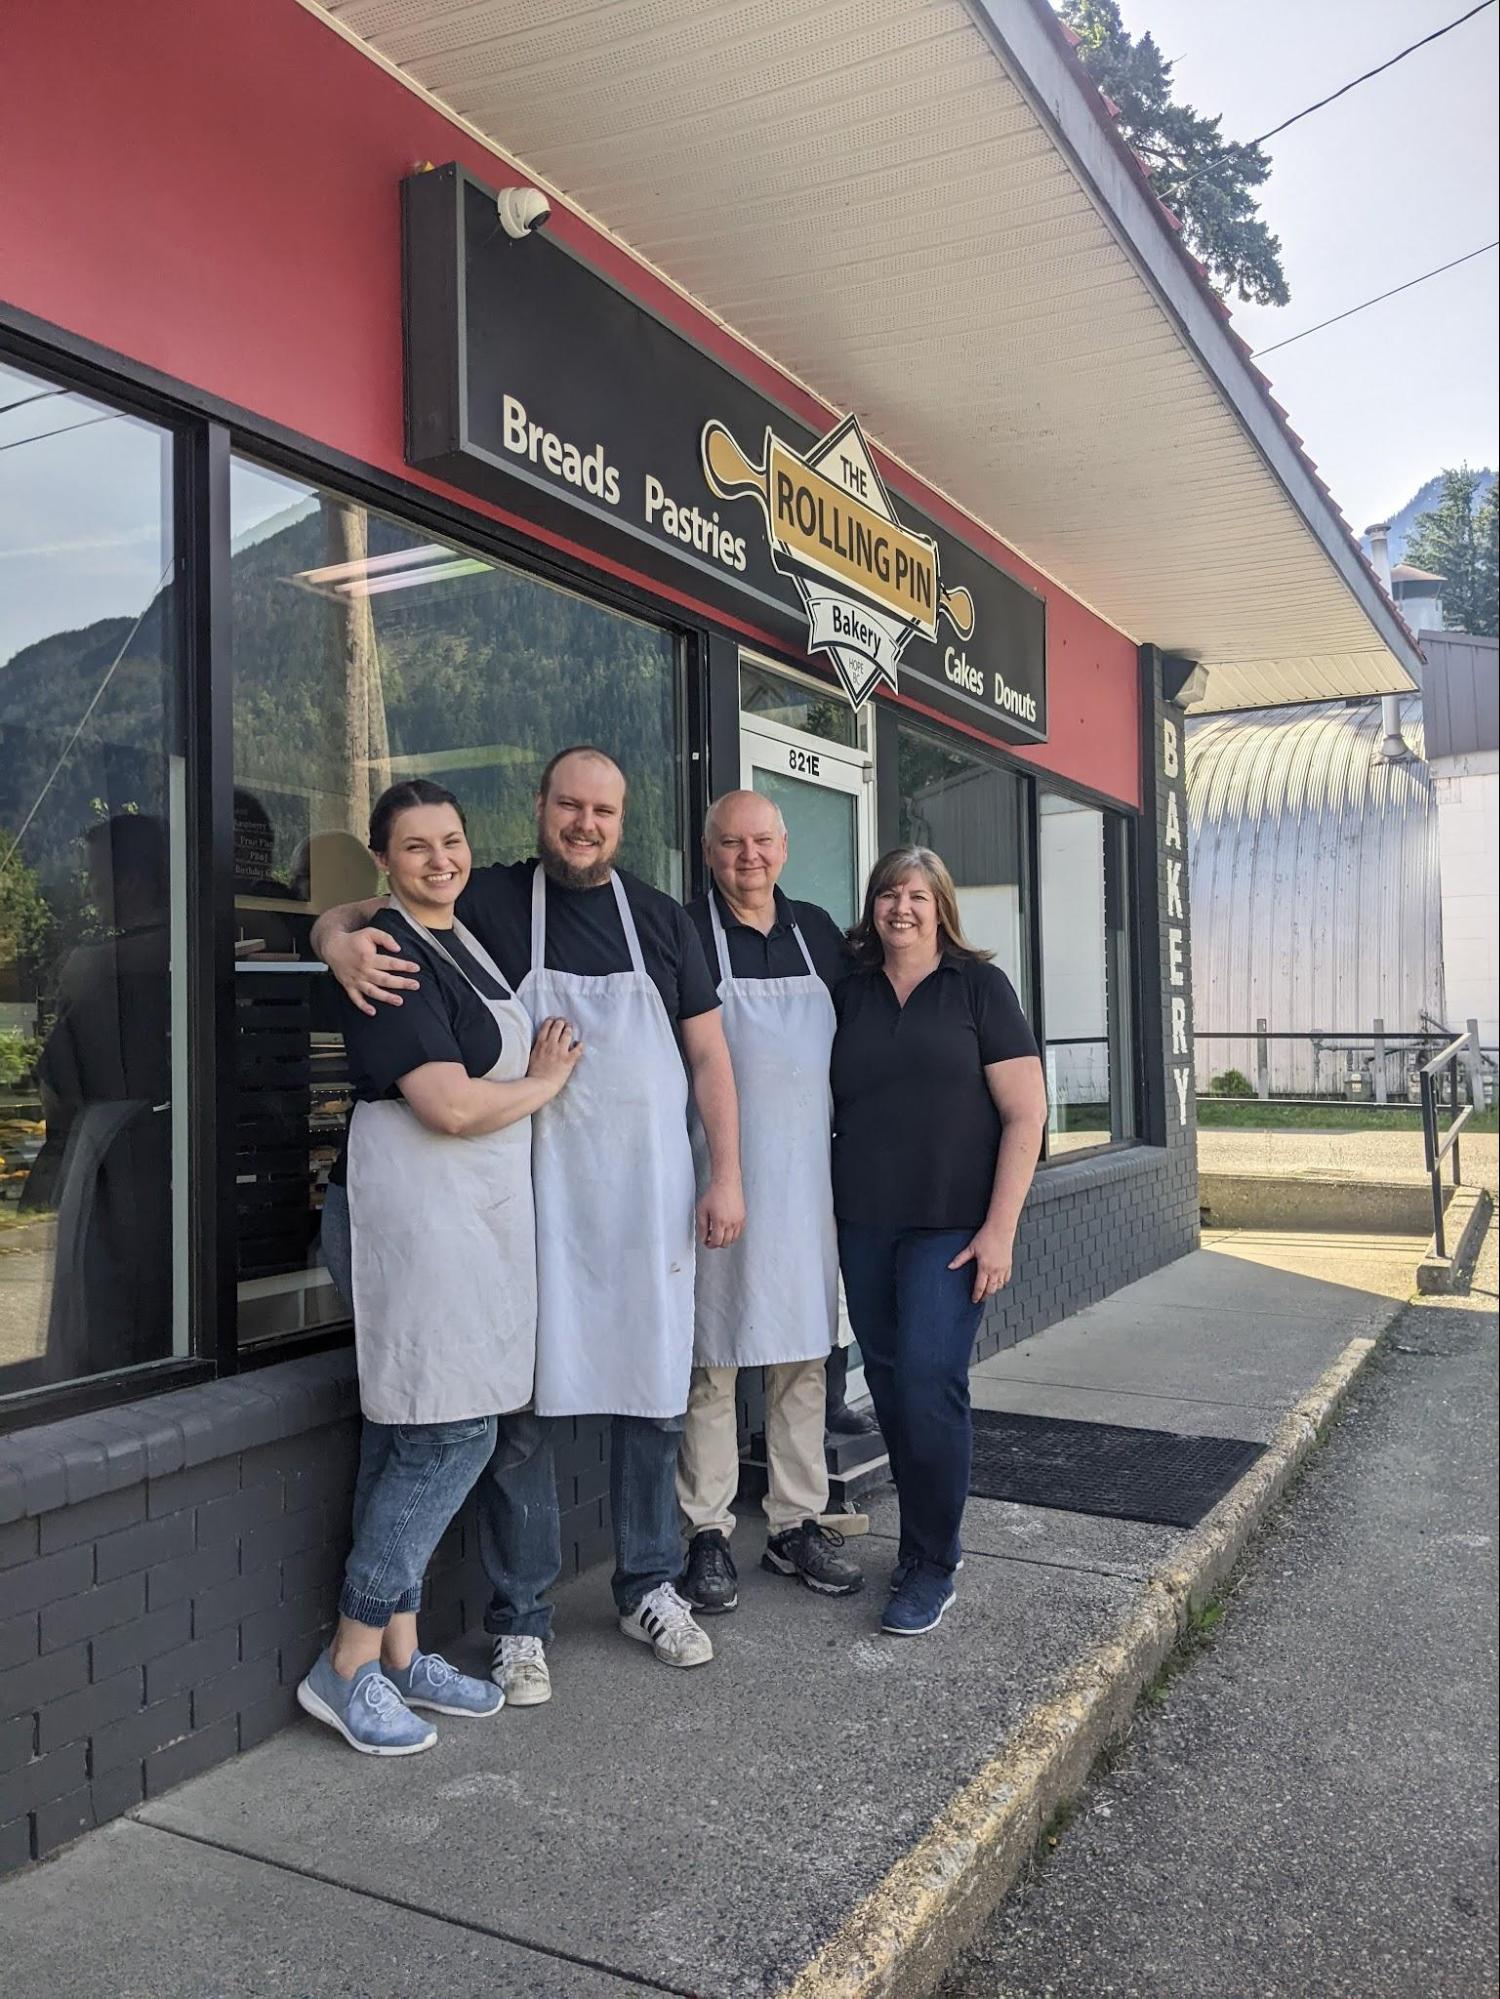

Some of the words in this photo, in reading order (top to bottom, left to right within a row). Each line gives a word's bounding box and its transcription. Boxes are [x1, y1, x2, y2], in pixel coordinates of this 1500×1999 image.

[503, 394, 621, 505] Breads
[645, 473, 747, 572] Pastries
[840, 455, 868, 498] THE
[777, 470, 890, 583] ROLLING
[895, 548, 931, 609] PIN
[832, 605, 881, 659] Bakery
[848, 657, 864, 675] HOPE
[944, 646, 984, 696] Cakes
[994, 672, 1037, 723] Donuts
[789, 749, 820, 777] 821E
[1161, 717, 1189, 1127] BAKERY
